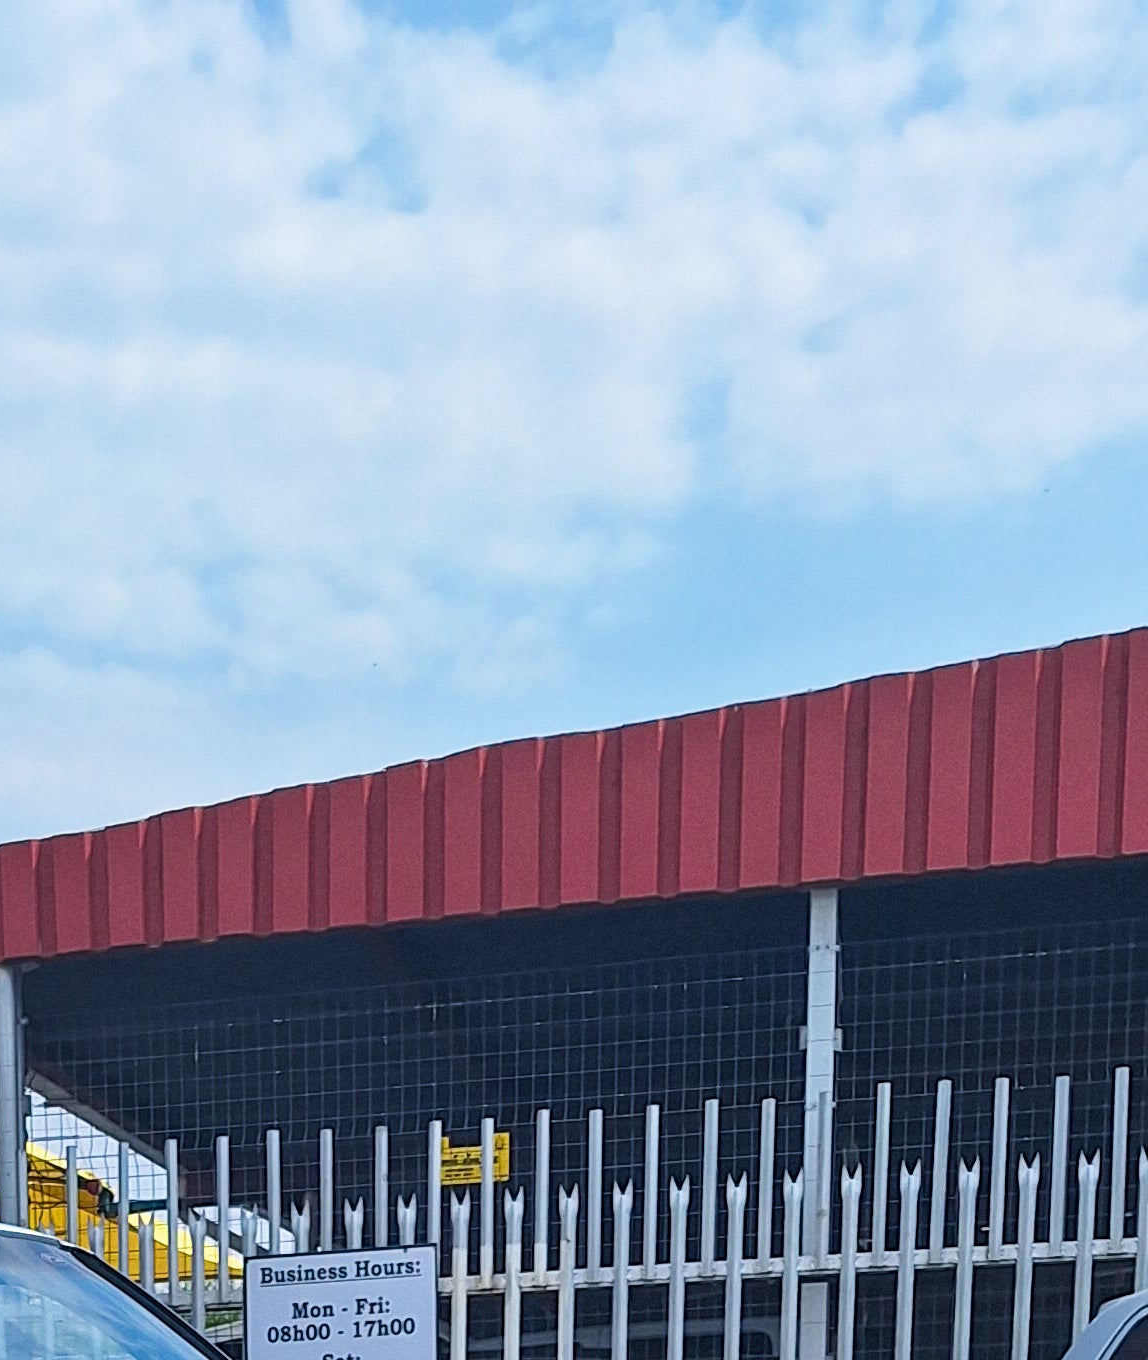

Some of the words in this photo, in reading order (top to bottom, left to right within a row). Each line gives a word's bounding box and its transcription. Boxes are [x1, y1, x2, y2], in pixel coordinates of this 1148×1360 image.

[260, 1264, 348, 1284] Business
[355, 1260, 422, 1278] Hours:
[292, 1302, 335, 1319] Mon
[355, 1296, 391, 1316] Fri:
[267, 1323, 331, 1343] 08h00
[353, 1318, 416, 1338] 17h00
